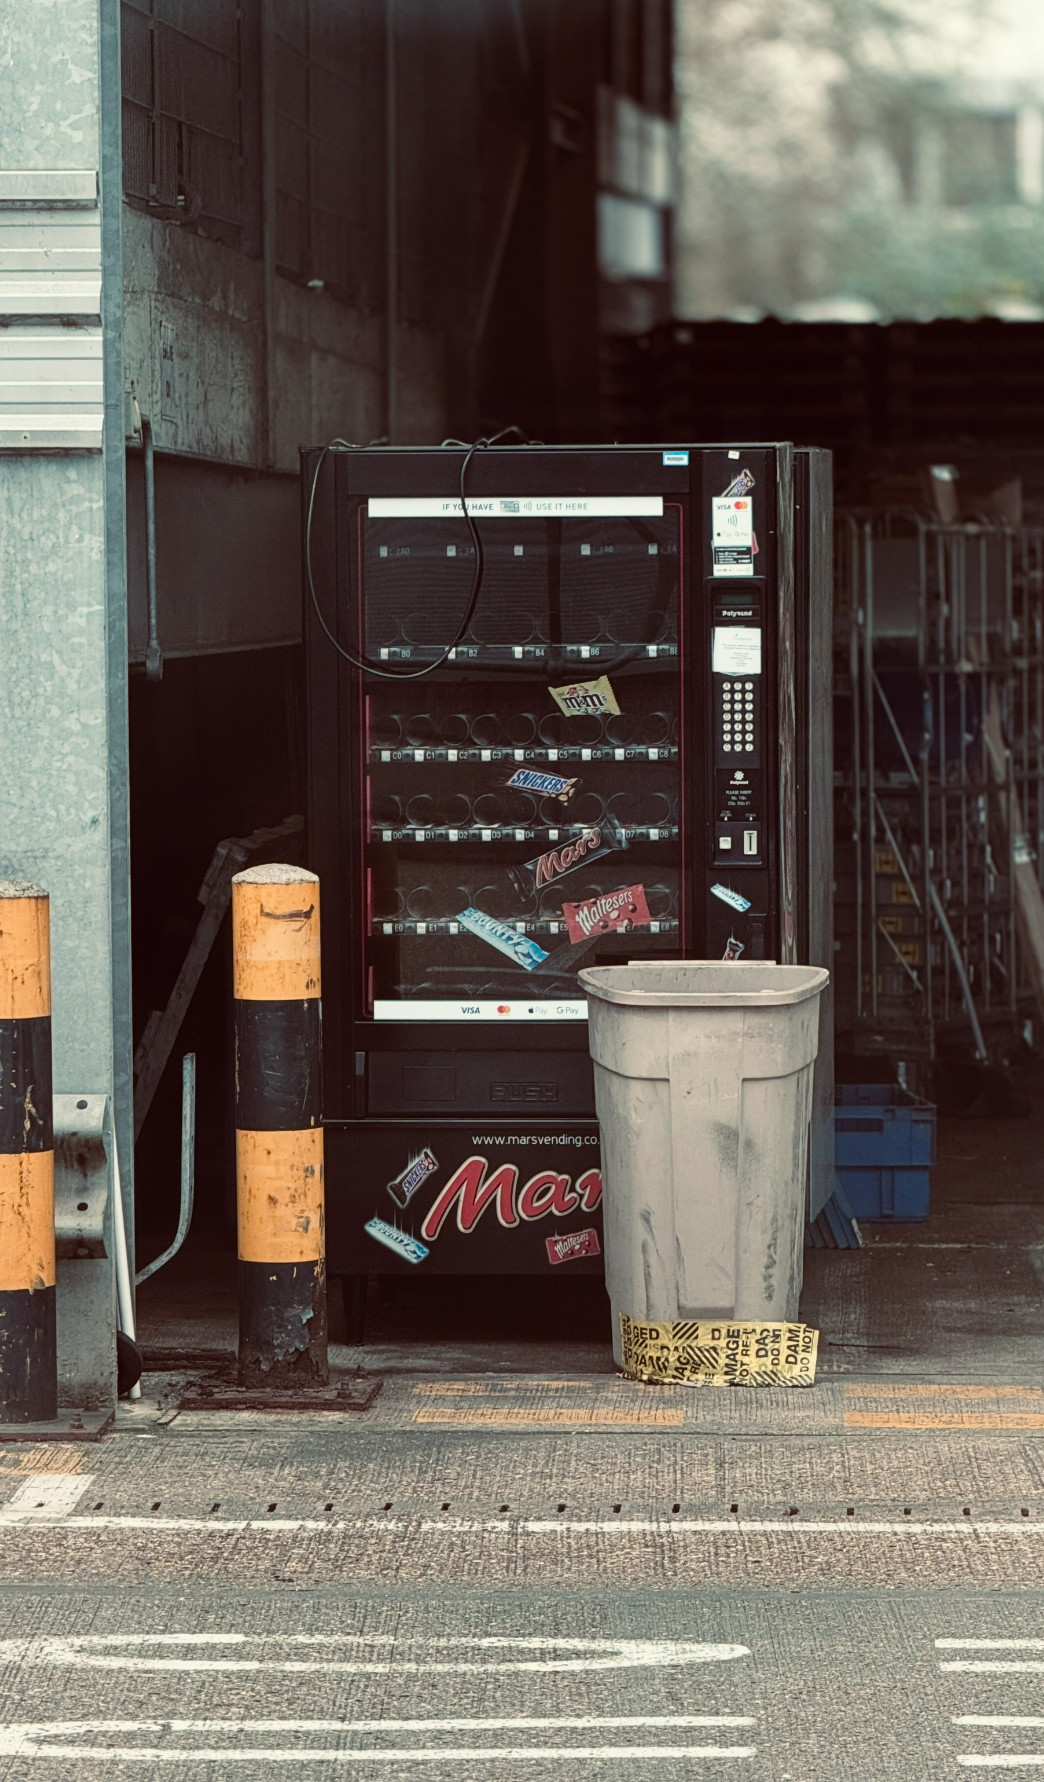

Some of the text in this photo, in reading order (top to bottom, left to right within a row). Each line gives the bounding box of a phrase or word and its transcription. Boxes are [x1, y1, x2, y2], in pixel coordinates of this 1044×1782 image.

[442, 503, 450, 511] IF
[472, 503, 494, 511] HAVE
[536, 502, 553, 510] USE
[555, 502, 563, 510] IT
[565, 502, 588, 510] HERE
[401, 649, 411, 658] B0
[468, 649, 478, 657] B2
[535, 648, 545, 656] B4
[590, 648, 600, 656] B6
[392, 751, 402, 760] C0
[426, 751, 435, 760] C1
[458, 751, 468, 760] C2
[492, 751, 502, 759] C3
[525, 750, 535, 759] C4
[558, 750, 568, 759] C5
[592, 750, 601, 758] C6
[625, 750, 635, 758] C7
[659, 750, 669, 758] C8
[511, 769, 567, 793] SNICKERS
[425, 830, 435, 839] D1
[458, 830, 468, 839] D2
[491, 830, 501, 839] D3
[524, 830, 535, 839] D4
[625, 830, 635, 838] D7
[659, 830, 669, 838] D8
[535, 826, 601, 889] Mars
[575, 890, 634, 937] Maltesers
[428, 923, 437, 932] E1
[469, 911, 525, 945] BOUNTY
[526, 923, 535, 932] E4
[661, 923, 670, 931] E8
[460, 1006, 481, 1014] VISA
[535, 1006, 548, 1015] Pay
[565, 1006, 579, 1015] Pay
[492, 1085, 558, 1100] PUSH
[403, 1160, 427, 1194] SNICKERS
[554, 1233, 589, 1259] Maltesers
[799, 1328, 813, 1373] DO NOT
[770, 1348, 781, 1367] DO
